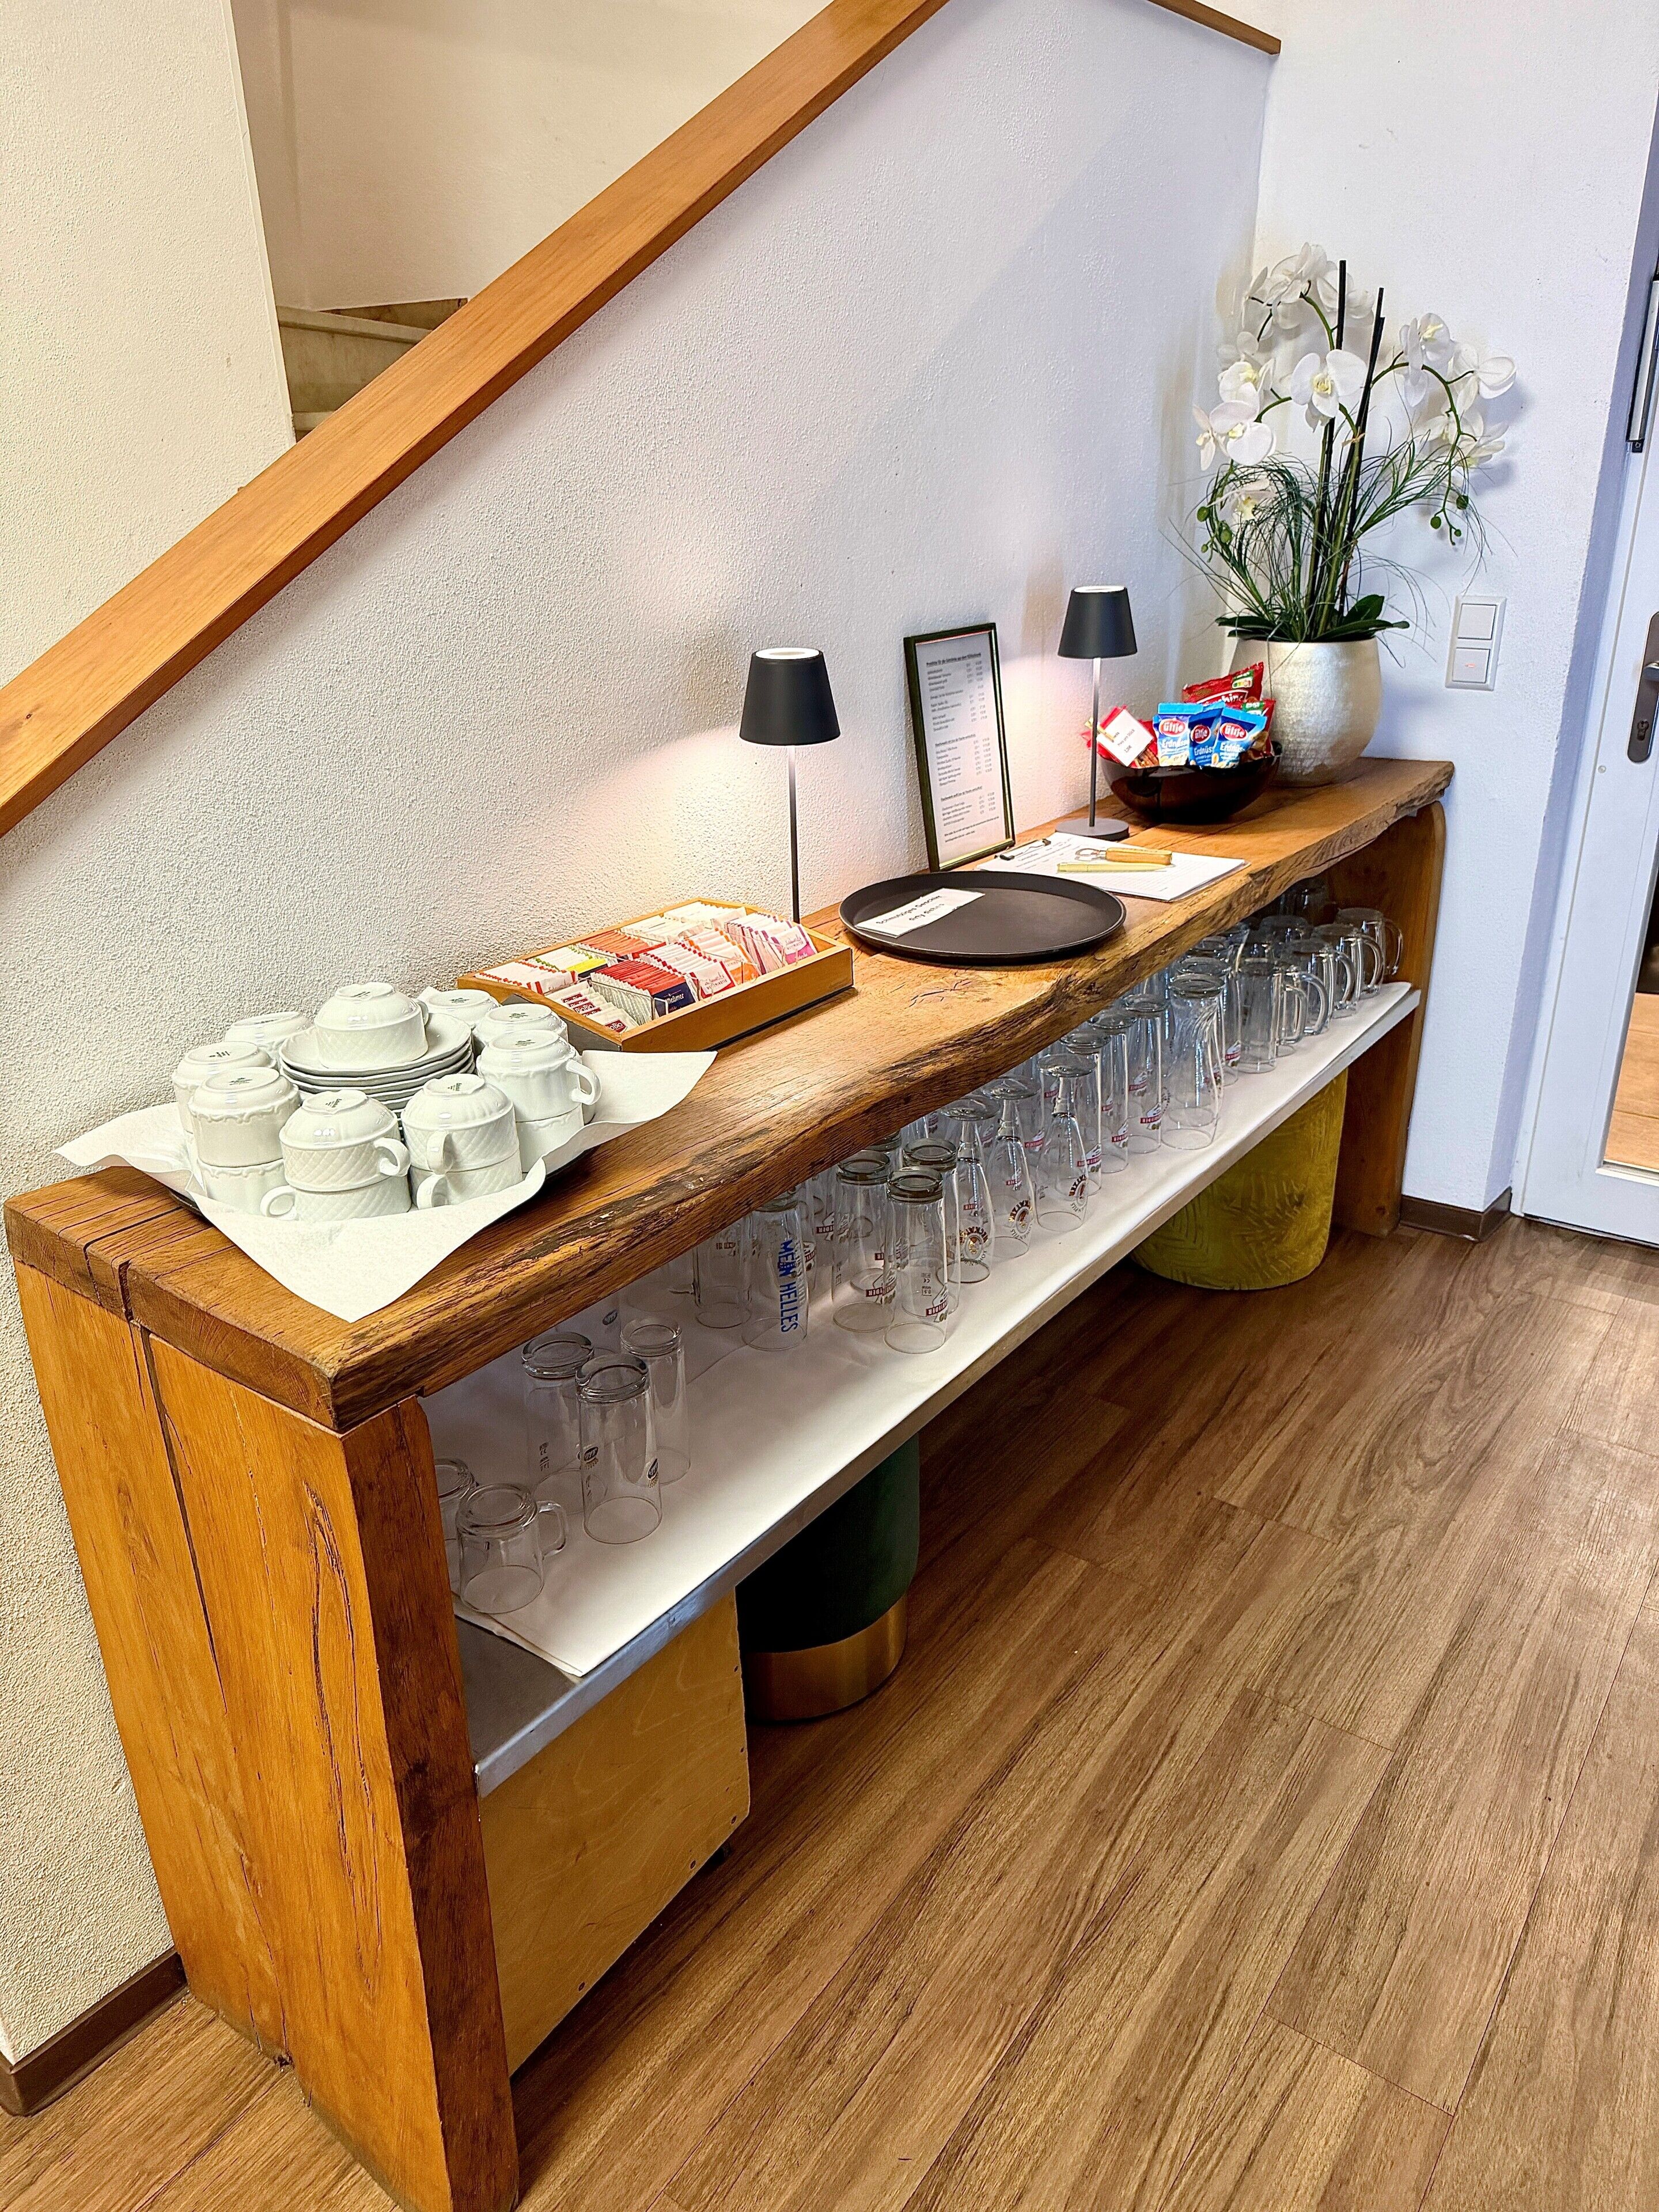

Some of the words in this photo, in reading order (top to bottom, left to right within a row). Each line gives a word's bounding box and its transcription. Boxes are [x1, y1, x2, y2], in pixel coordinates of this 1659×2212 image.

[1162, 721, 1184, 733] ültje
[1225, 725, 1245, 738] ültje
[1194, 728, 1208, 740] ültje
[779, 1281, 799, 1332] HELLES
